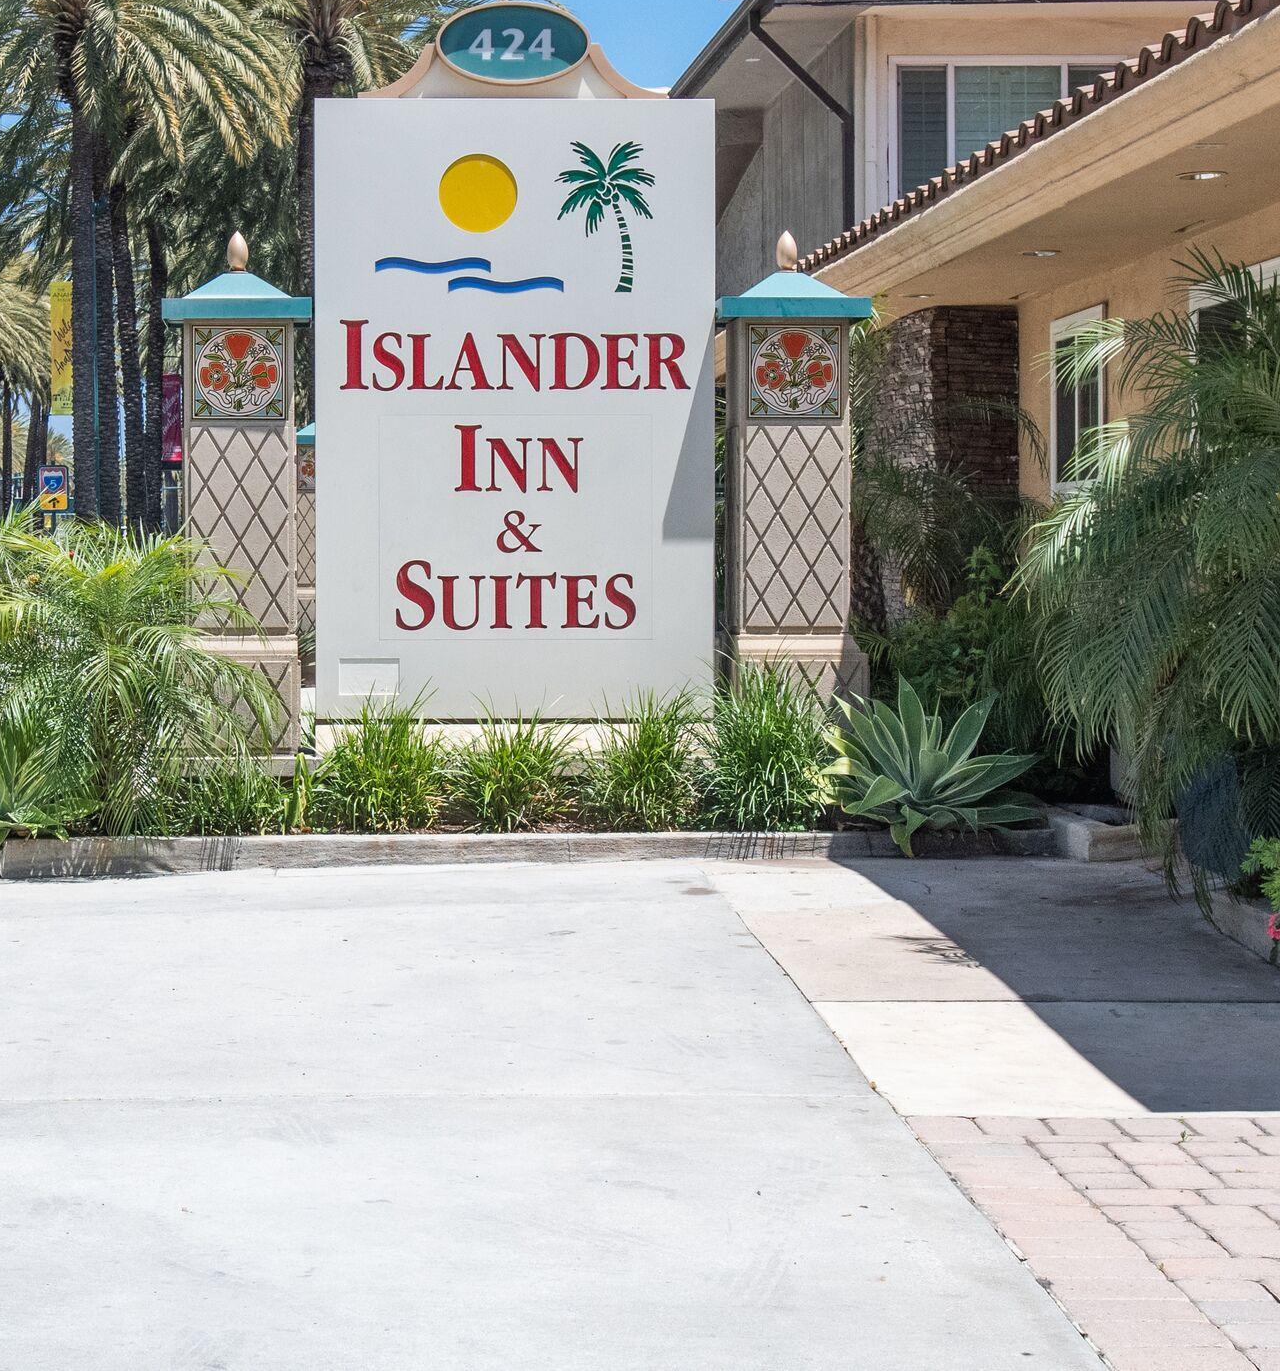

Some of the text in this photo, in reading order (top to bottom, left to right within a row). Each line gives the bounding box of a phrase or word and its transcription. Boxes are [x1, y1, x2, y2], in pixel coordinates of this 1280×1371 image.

[468, 28, 556, 60] 424
[339, 319, 691, 392] ISLANDER
[50, 479, 57, 489] 5
[454, 424, 584, 494] INN
[496, 510, 543, 553] &
[395, 560, 637, 631] SUITES
